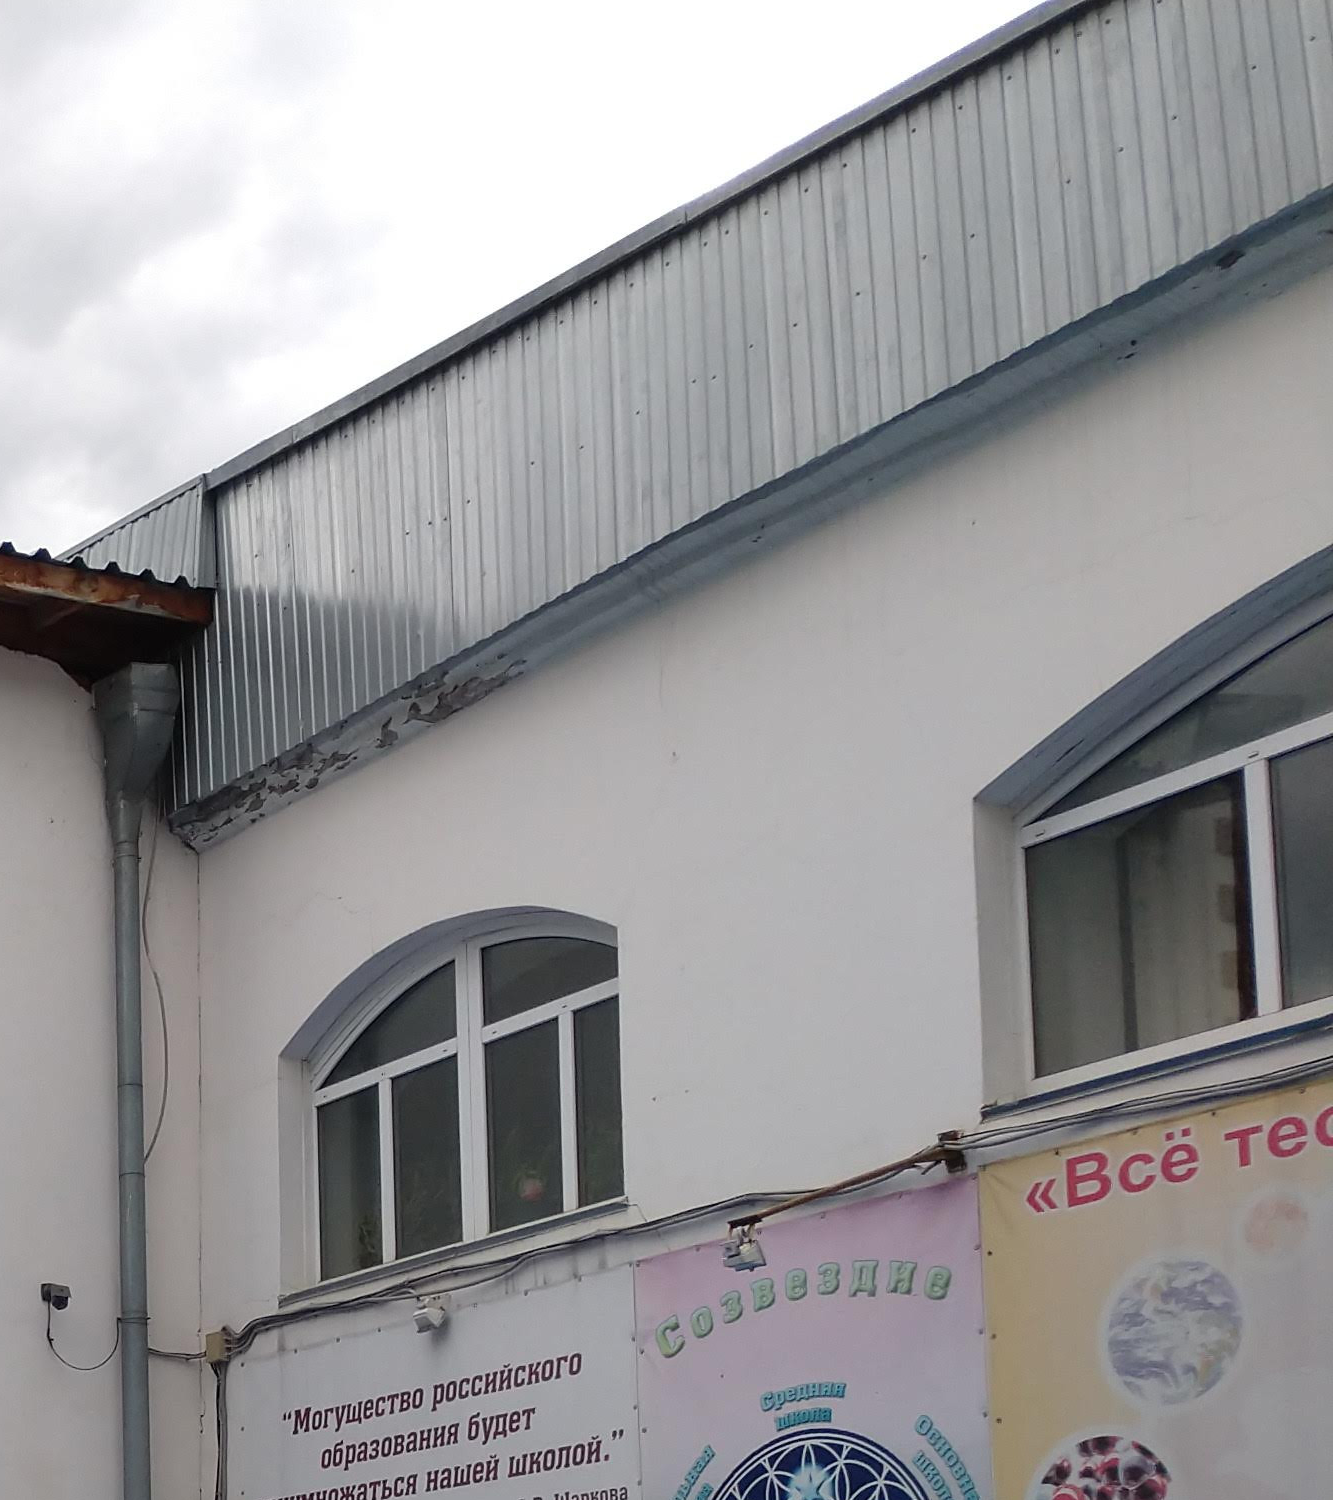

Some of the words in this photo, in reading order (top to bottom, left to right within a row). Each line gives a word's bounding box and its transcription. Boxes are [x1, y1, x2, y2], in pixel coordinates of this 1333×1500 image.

[1025, 1127, 1200, 1213] «Всё
[655, 1259, 953, 1359] Созвездие
[282, 1385, 424, 1434] “Могущество
[432, 1351, 583, 1405] российского
[760, 1382, 847, 1412] Средняя
[775, 1406, 832, 1431] школа
[320, 1419, 459, 1472] образования
[467, 1405, 536, 1443] будет
[425, 1453, 500, 1493] нашей
[508, 1429, 625, 1478] школой.”
